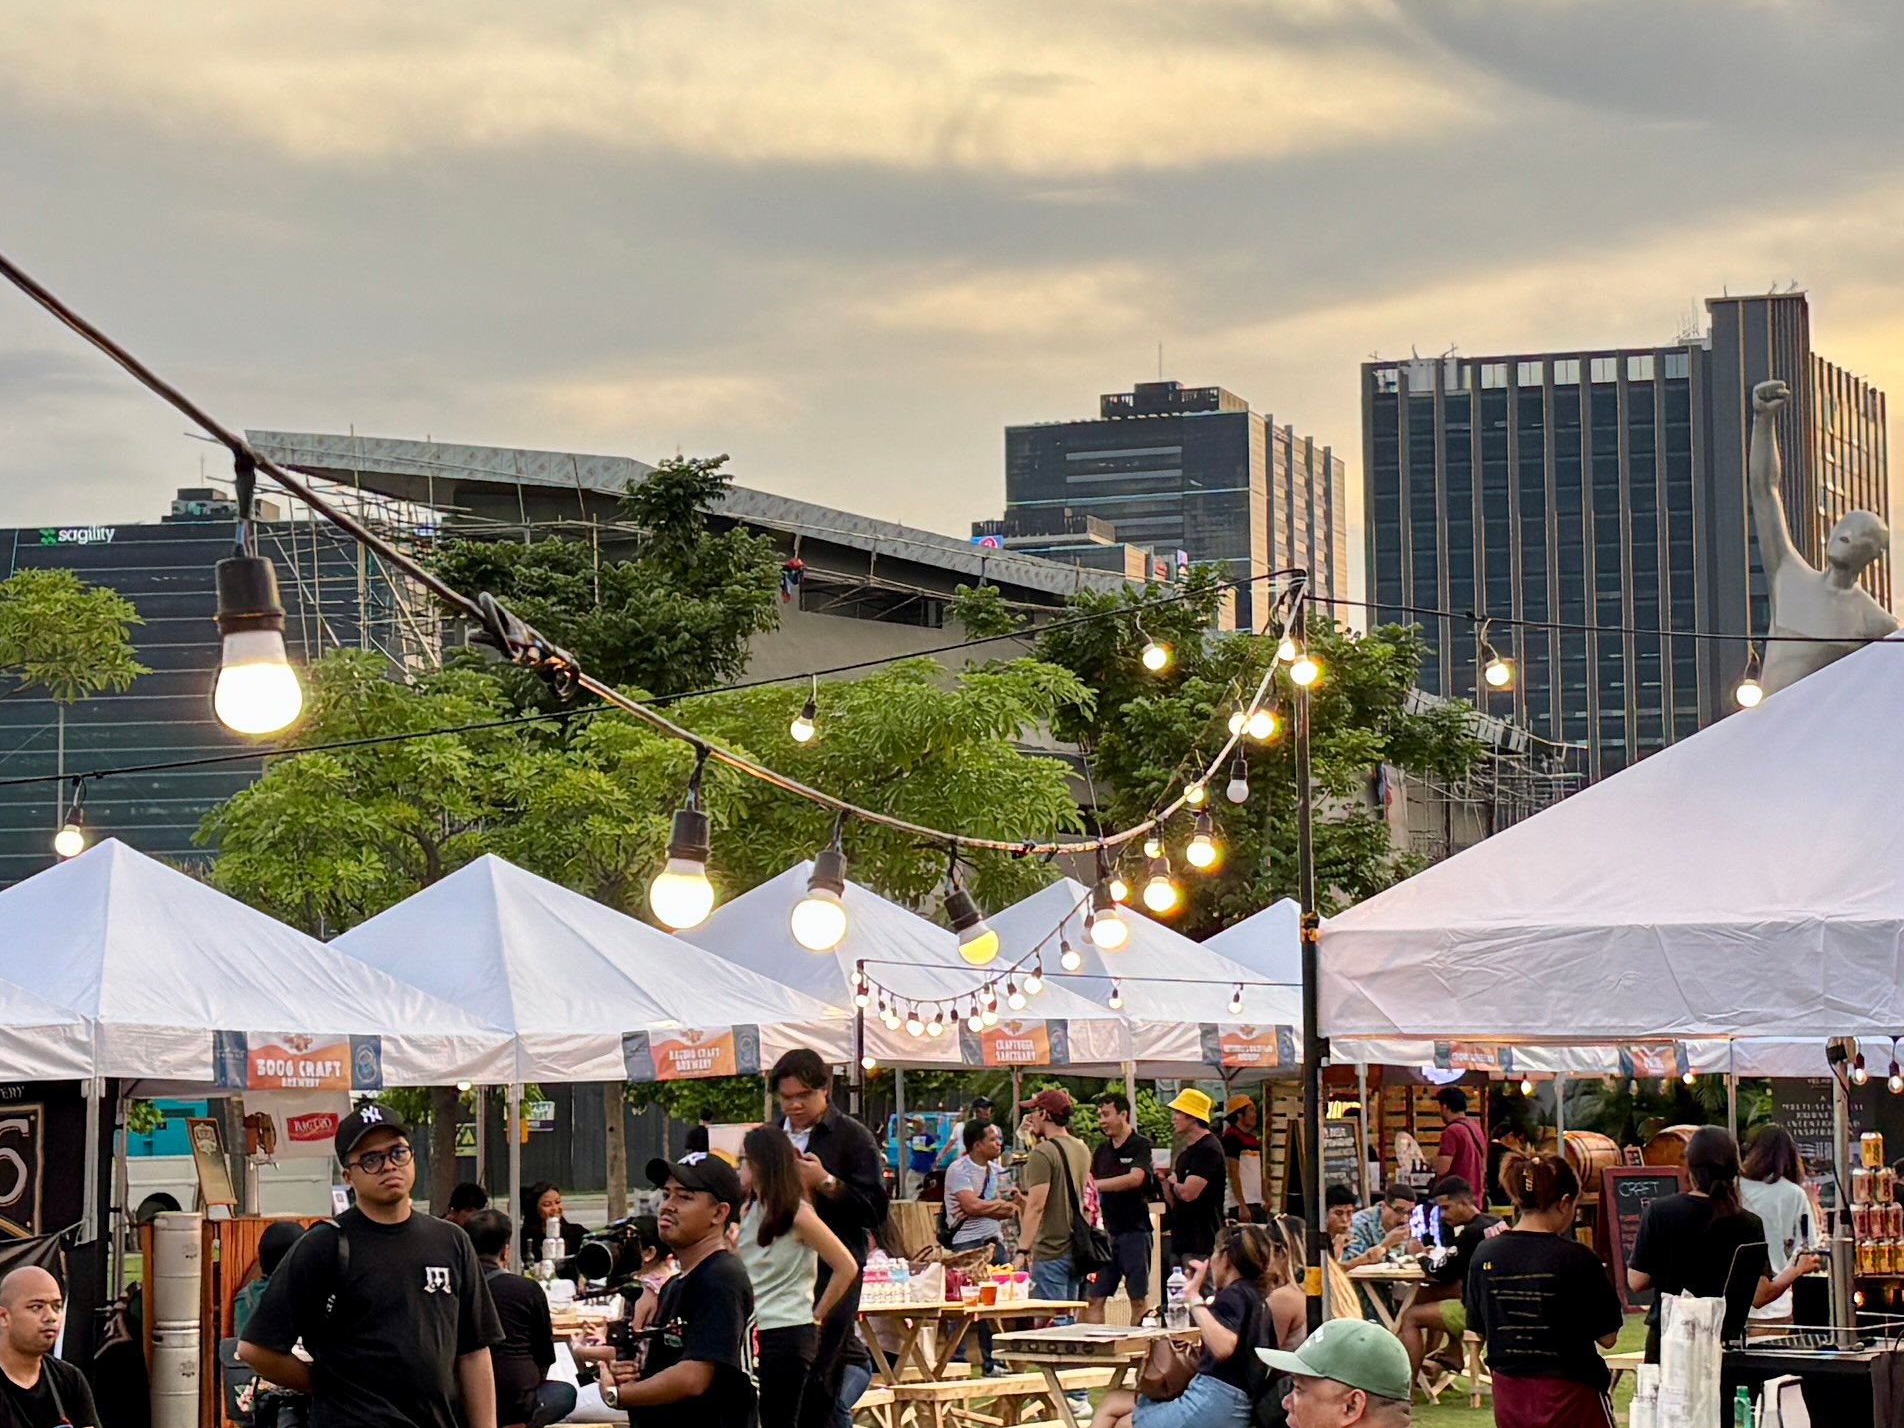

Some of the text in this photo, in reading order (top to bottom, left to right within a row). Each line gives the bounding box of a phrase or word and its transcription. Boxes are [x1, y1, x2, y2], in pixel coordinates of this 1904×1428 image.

[58, 525, 115, 545] sagility
[256, 1059, 342, 1077] 3006 CRAFT
